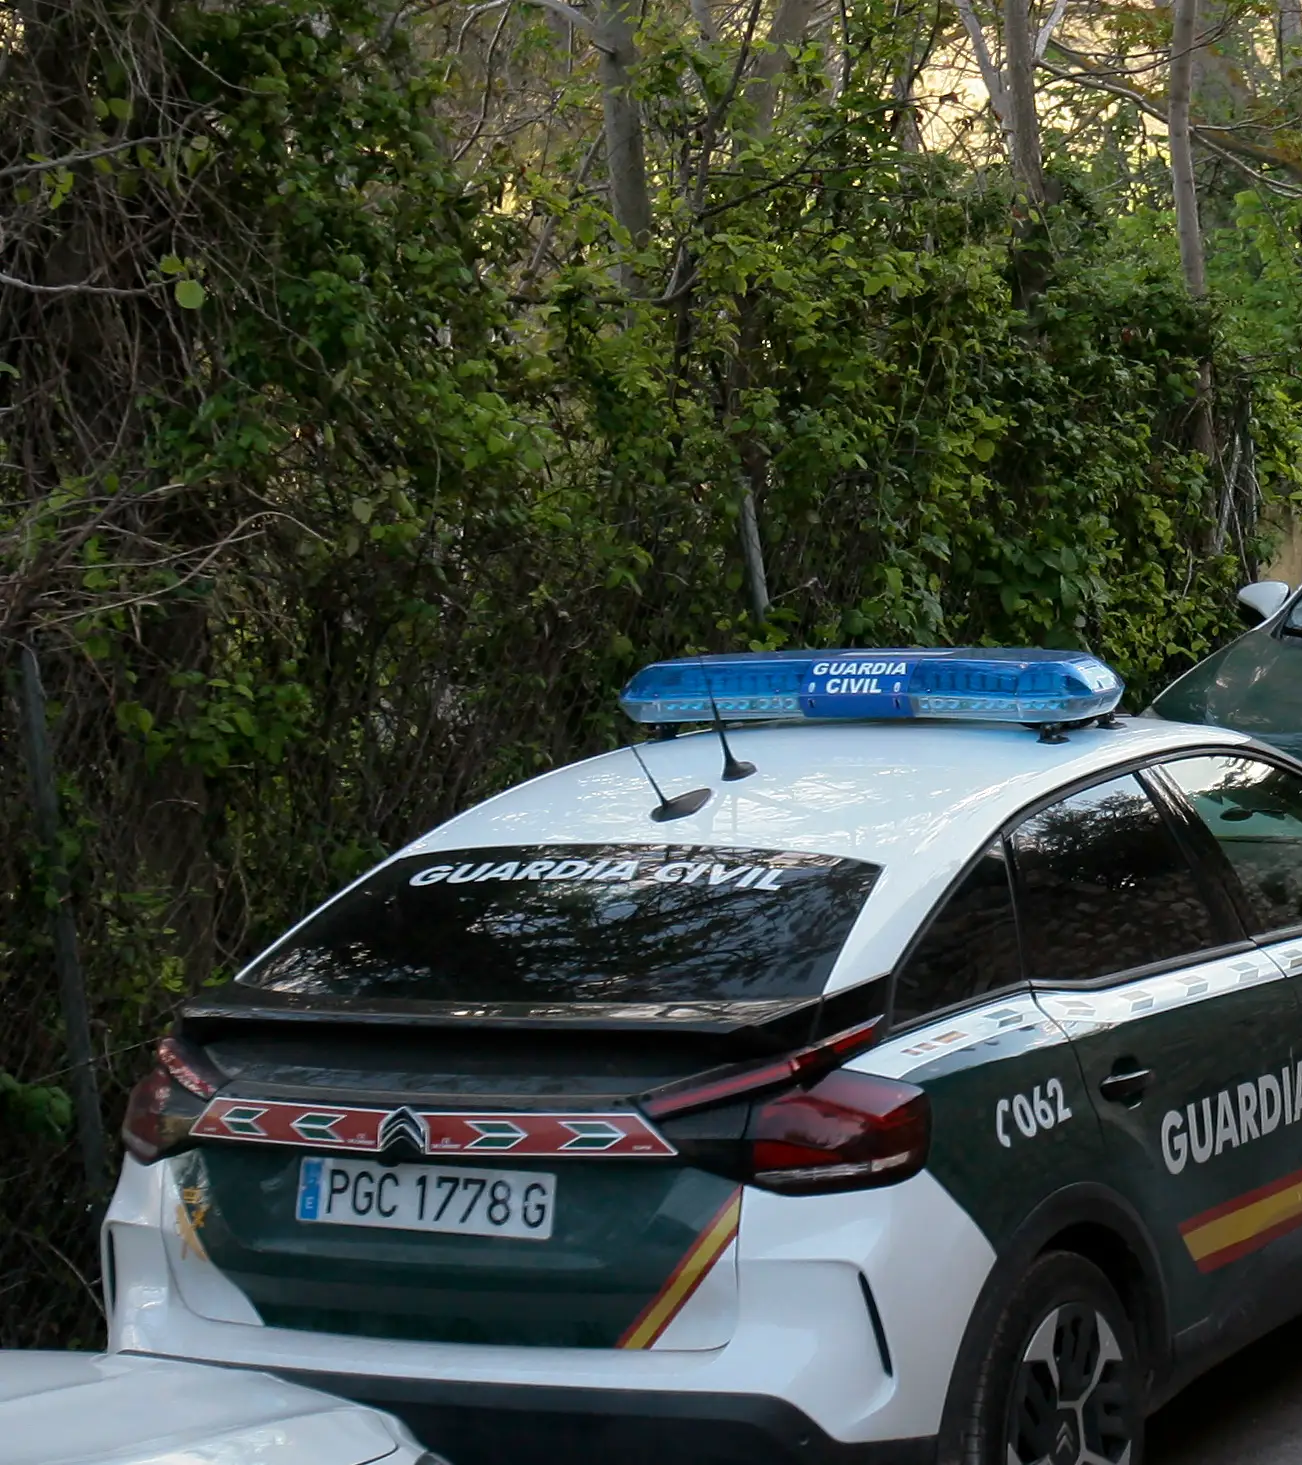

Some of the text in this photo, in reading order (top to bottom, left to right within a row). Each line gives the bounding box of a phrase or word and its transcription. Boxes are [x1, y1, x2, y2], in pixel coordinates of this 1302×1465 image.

[812, 662, 906, 676] GUARDIA
[825, 678, 882, 694] CIVIL
[409, 860, 784, 892] GUARDIA CIVIL
[325, 1168, 547, 1229] PGC 1778 G
